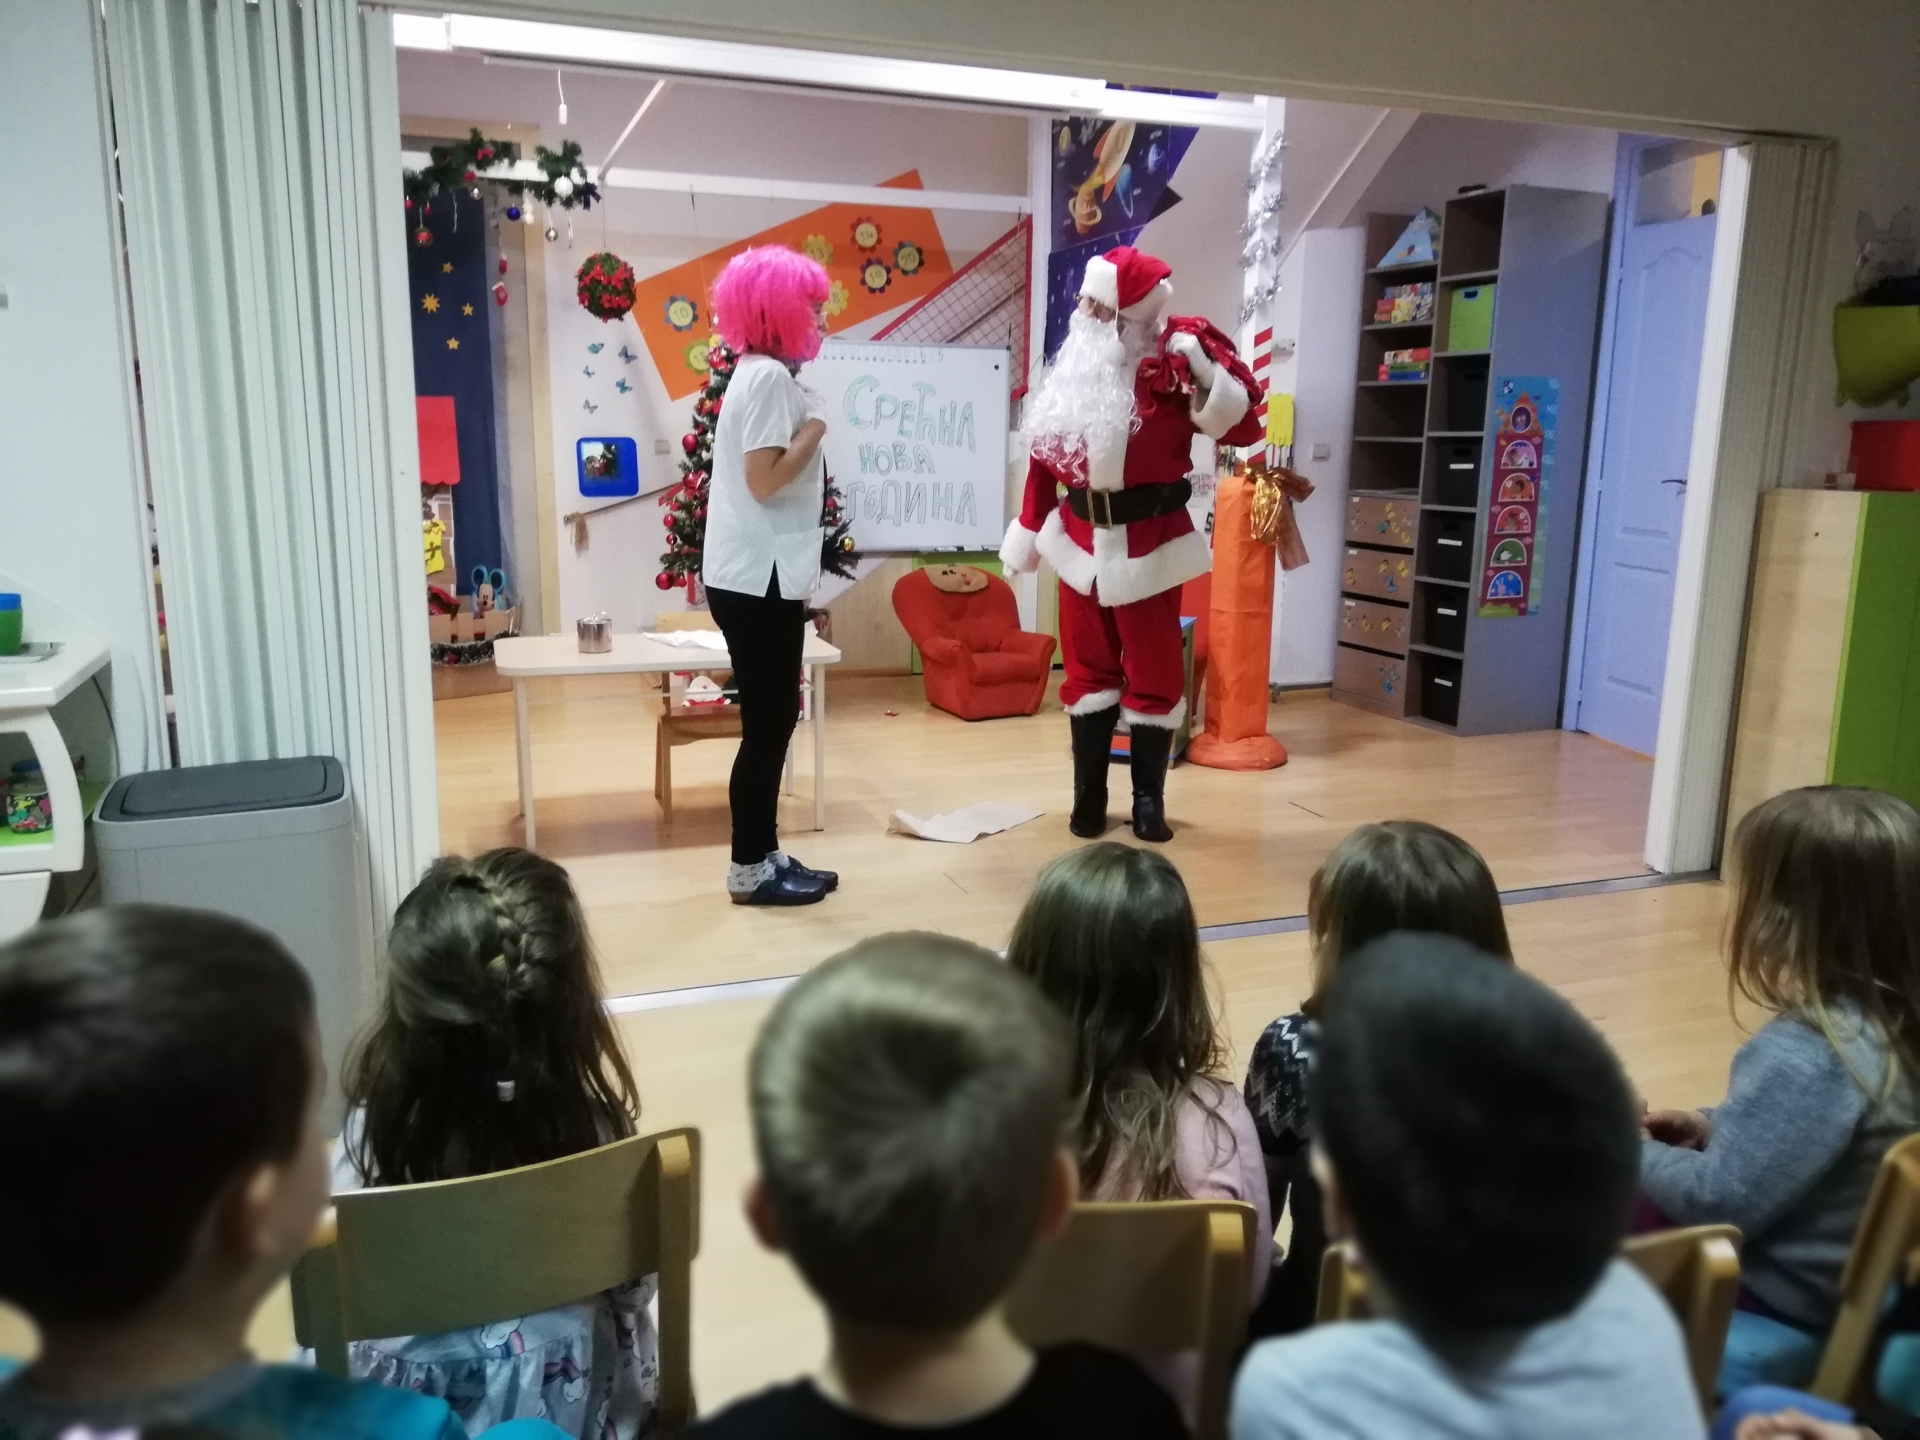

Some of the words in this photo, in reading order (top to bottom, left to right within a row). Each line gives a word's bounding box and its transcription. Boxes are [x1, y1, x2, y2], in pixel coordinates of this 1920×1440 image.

[860, 229, 874, 242] 14
[811, 248, 825, 260] 13
[901, 252, 916, 266] 20
[869, 269, 883, 284] 19
[674, 307, 689, 321] 10
[843, 374, 977, 454] СРЕЋНА
[858, 441, 936, 476] НОВА
[846, 480, 978, 527] ГОДИНА
